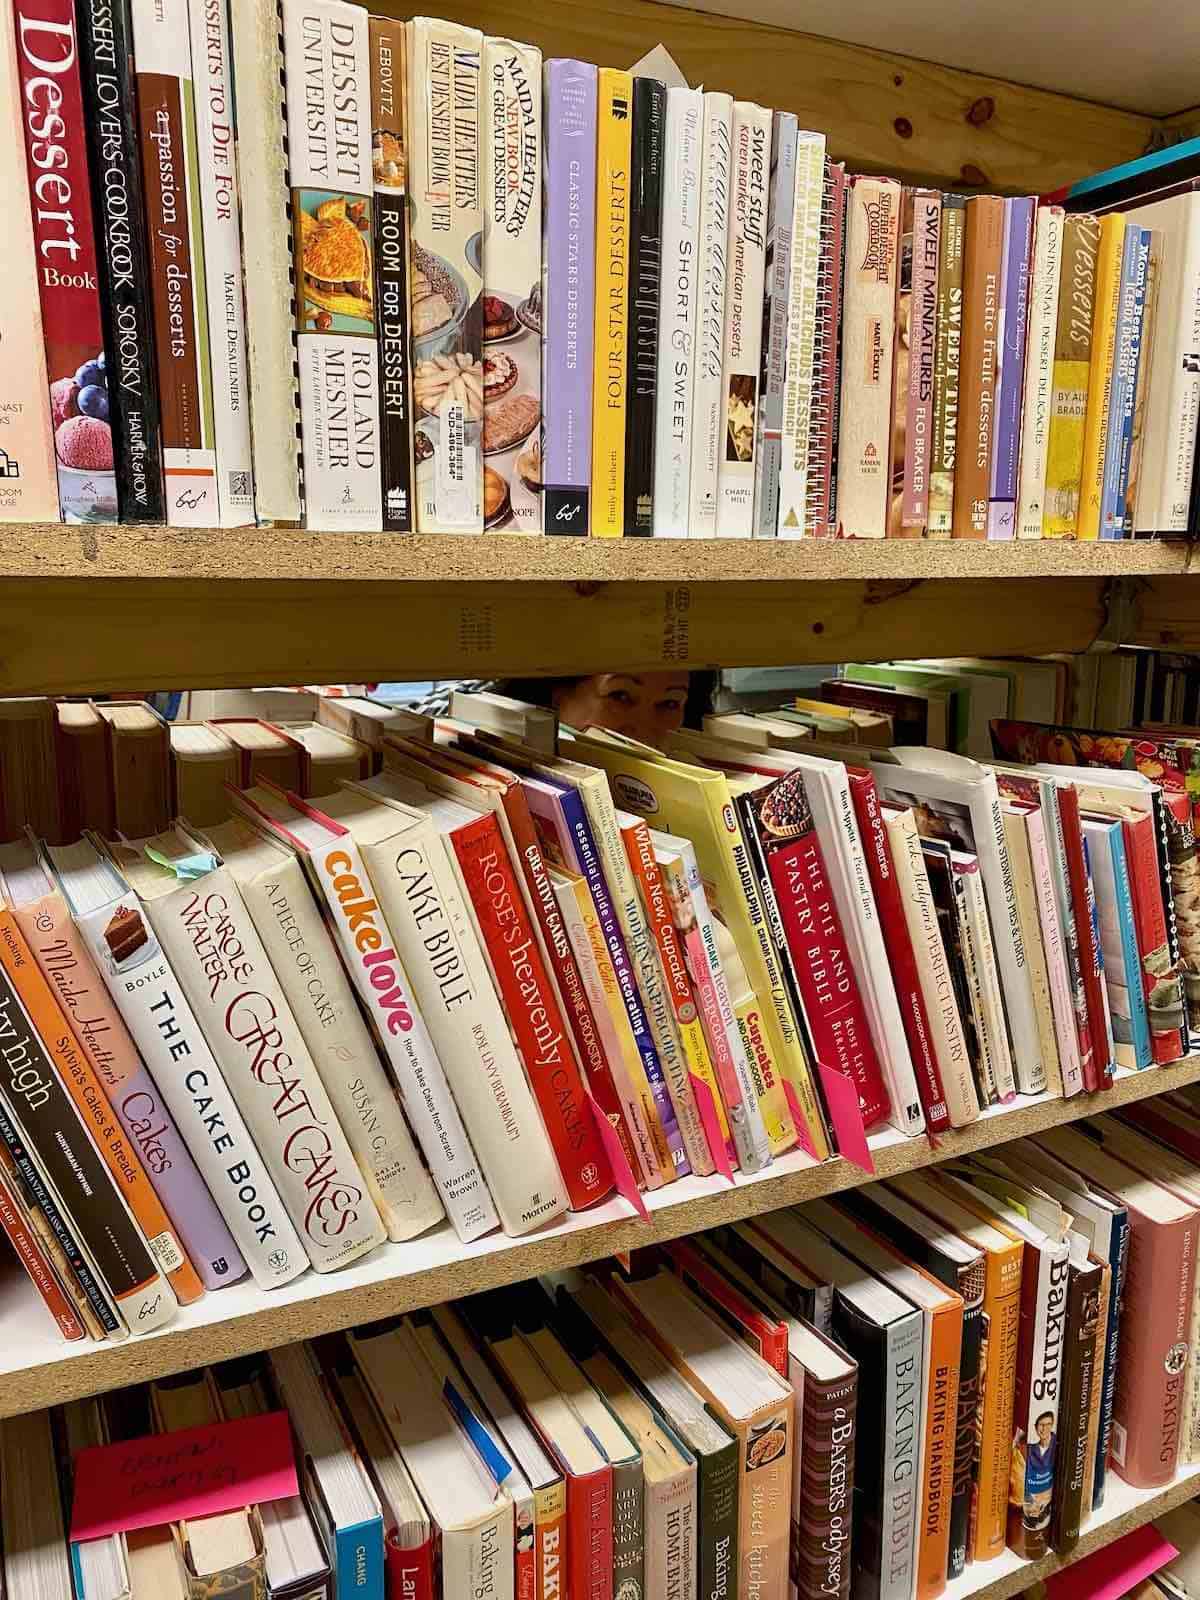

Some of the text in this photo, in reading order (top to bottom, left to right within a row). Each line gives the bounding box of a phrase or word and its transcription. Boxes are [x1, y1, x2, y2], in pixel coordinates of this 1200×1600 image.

[156, 111, 170, 122] a
[302, 16, 328, 180] UNIVERSITY
[330, 19, 361, 184] DESSERT
[378, 35, 394, 116] LEBOVITZ
[431, 41, 451, 186] BEST DESSERT BOOK
[505, 55, 537, 127] MAIDA
[19, 11, 81, 262] Dessert
[150, 130, 180, 224] passion
[209, 85, 234, 221] TO DIE FOR
[492, 63, 507, 224] OF GREAT DESSERTS
[505, 95, 520, 193] NEW BOOK
[648, 92, 661, 176] Emily Luchetti
[104, 167, 135, 290] COOKBOOK
[743, 126, 766, 250] sweet stuff
[43, 267, 97, 289] Book
[158, 230, 183, 257] for
[566, 159, 581, 370] CLASSIC STARS DESSERTS
[676, 239, 693, 323] SHORT
[730, 124, 749, 361] Karen Barker's American Desserts
[878, 191, 892, 285] SUPERB DESSERT
[166, 263, 188, 358] desserts
[381, 209, 404, 420] ROOM FOR DESSERT
[607, 168, 626, 410] FOUR-STAR DESSERTS
[918, 205, 939, 402] SWEET MINIATURES
[1124, 243, 1151, 417] Mom's Best Desserts
[117, 303, 142, 396] SOROSKY
[224, 272, 240, 412] MARCEL DESAULNIERS
[671, 329, 691, 357] &
[788, 341, 798, 377] ALICE
[942, 287, 962, 469] SWEET TIMES
[976, 274, 996, 467] rustic fruit desserts
[1038, 324, 1051, 371] DESSERT
[324, 347, 350, 470] MESNIER
[351, 350, 376, 470] ROLAND
[672, 361, 688, 443] SWEET
[793, 383, 809, 472] DESSERTS
[1058, 391, 1070, 401] BY
[724, 487, 753, 497] CHAPEL
[912, 407, 926, 493] FLO BRAKER
[608, 495, 618, 525] Emily
[729, 496, 747, 505] HILL
[840, 789, 849, 810] Bon
[865, 788, 890, 880] Pies Pastries
[204, 893, 256, 985] CAROLE
[395, 848, 473, 1012] CAKE BIBLE
[523, 843, 571, 960] CREATIVE CAKES
[590, 879, 610, 917] guide
[603, 919, 615, 932] to
[633, 823, 659, 881] What's
[659, 923, 691, 998] Cupcake?
[731, 843, 780, 987] PHILADELPHIA CREAM CHEESE
[784, 855, 834, 1005] PASTRY BIBLE
[803, 845, 850, 993] THE PIE AND
[861, 897, 873, 921] Tarts
[1006, 901, 1025, 968] PIES TARTS
[0, 926, 26, 969] Hocking
[124, 964, 167, 993] BOYLE
[179, 890, 229, 1005] WALTER
[264, 881, 338, 1029] A OF CAKE
[478, 850, 564, 1066] ROSE'S heavenly
[606, 934, 624, 967] cake
[701, 923, 733, 1026] CUPCAKE heaven
[617, 964, 645, 1036] decorating
[941, 1004, 964, 1063] PASTRY
[1, 1036, 56, 1112] high
[471, 1022, 499, 1081] ROSE LEVY
[643, 1051, 654, 1070] Alex
[740, 1033, 767, 1097] OTHER GOODIES
[745, 1011, 776, 1090] Cupcakes
[844, 1016, 868, 1083] ROSE LEVY
[56, 1035, 137, 1185] Sylvia's Cakes & Breads
[120, 1090, 173, 1176] Cakes
[149, 989, 277, 1245] THE CAKE BOOK
[224, 990, 362, 1249] GREAT CAKES
[346, 1078, 382, 1135] SUSAN
[403, 1038, 457, 1162] How Bake Cakes from Scratch
[441, 1167, 477, 1190] Warren
[448, 1180, 479, 1200] Brown
[520, 1198, 559, 1223] Morrow
[1001, 1262, 1021, 1276] BEST
[1032, 1257, 1070, 1402] Baking
[825, 1384, 856, 1401] PATENT
[893, 1356, 914, 1483] BAKING
[1079, 1361, 1092, 1436] passion for
[1159, 1378, 1180, 1462] BAKING
[926, 1366, 949, 1538] BAKING HANDBOOK
[665, 1508, 681, 1566] HOME
[680, 1500, 692, 1576] The Complete
[750, 1483, 764, 1538] sweet
[767, 1486, 782, 1511] the
[820, 1407, 853, 1598] a BAKER'S odyssey
[889, 1489, 912, 1585] BIBLE
[355, 1545, 368, 1587] CHANG
